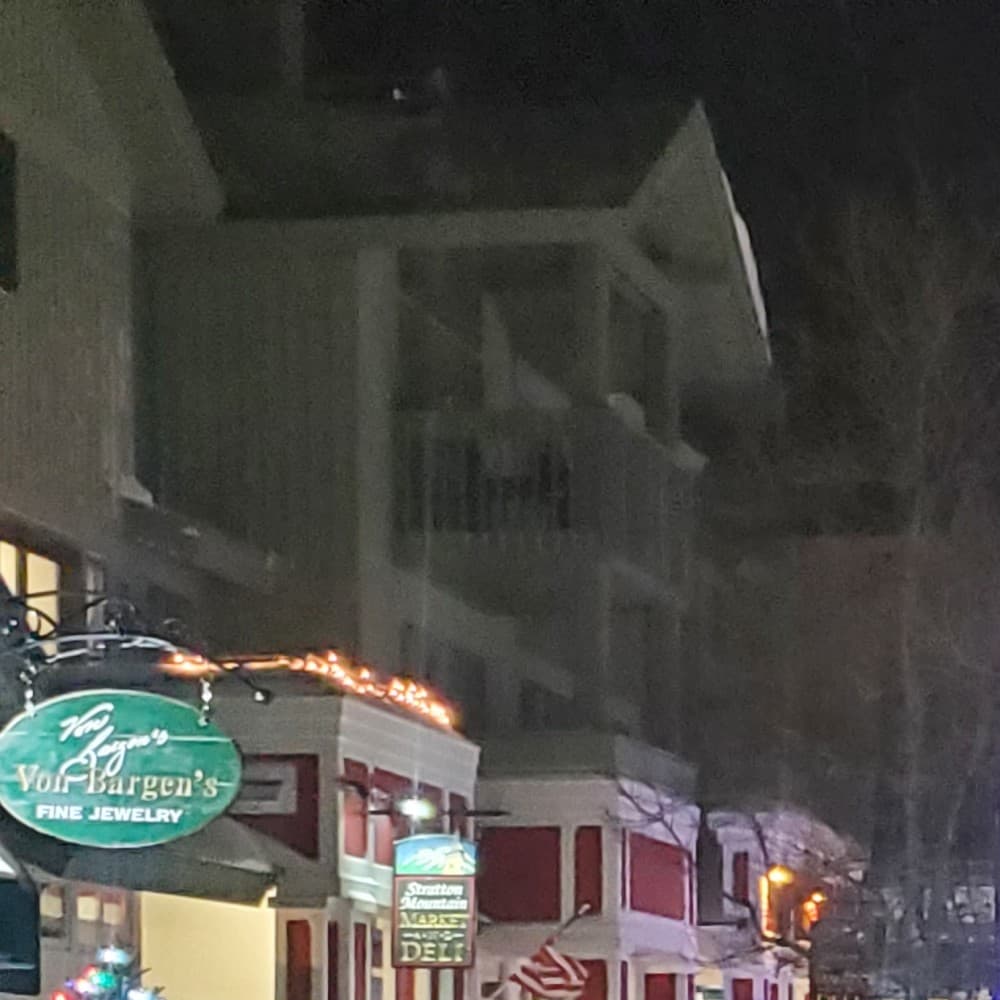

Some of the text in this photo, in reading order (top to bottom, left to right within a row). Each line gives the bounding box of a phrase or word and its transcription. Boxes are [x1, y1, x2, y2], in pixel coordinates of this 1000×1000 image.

[16, 763, 219, 801] Von Bargen's
[36, 804, 184, 823] FINE JEWELRY
[404, 881, 464, 897] Stratton
[399, 896, 468, 910] Mountain
[401, 941, 464, 962] DELI
